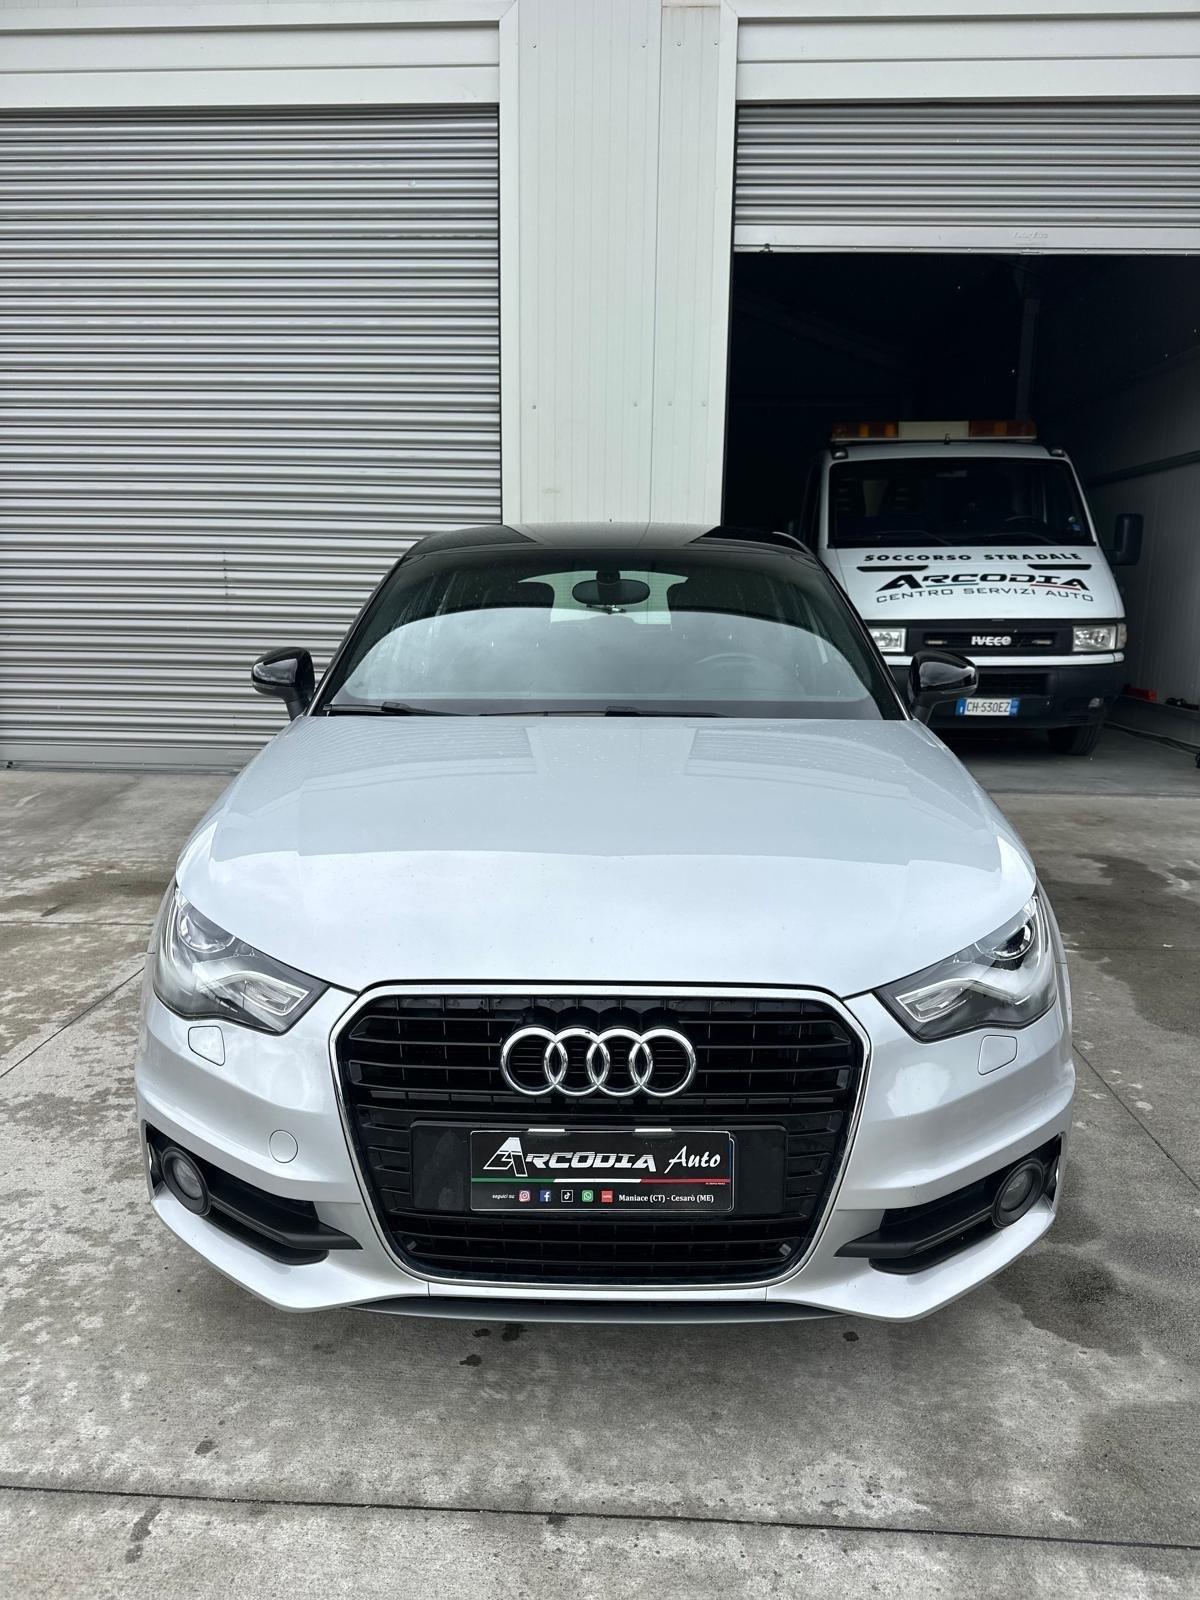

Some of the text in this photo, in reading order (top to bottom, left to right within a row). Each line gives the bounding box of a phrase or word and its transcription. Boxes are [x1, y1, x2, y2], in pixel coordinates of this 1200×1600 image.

[864, 552, 1082, 562] SOCCORSO STRADALE
[876, 573, 1090, 592] ARCODIA
[876, 587, 1094, 603] CENTRO SERVIZI AUTO
[971, 635, 1012, 646] IVECO
[483, 1136, 721, 1177] ARCODIA Auto
[649, 1194, 666, 1203] (CT)
[671, 1194, 695, 1202] Cesarò
[696, 1194, 715, 1203] (ME)
